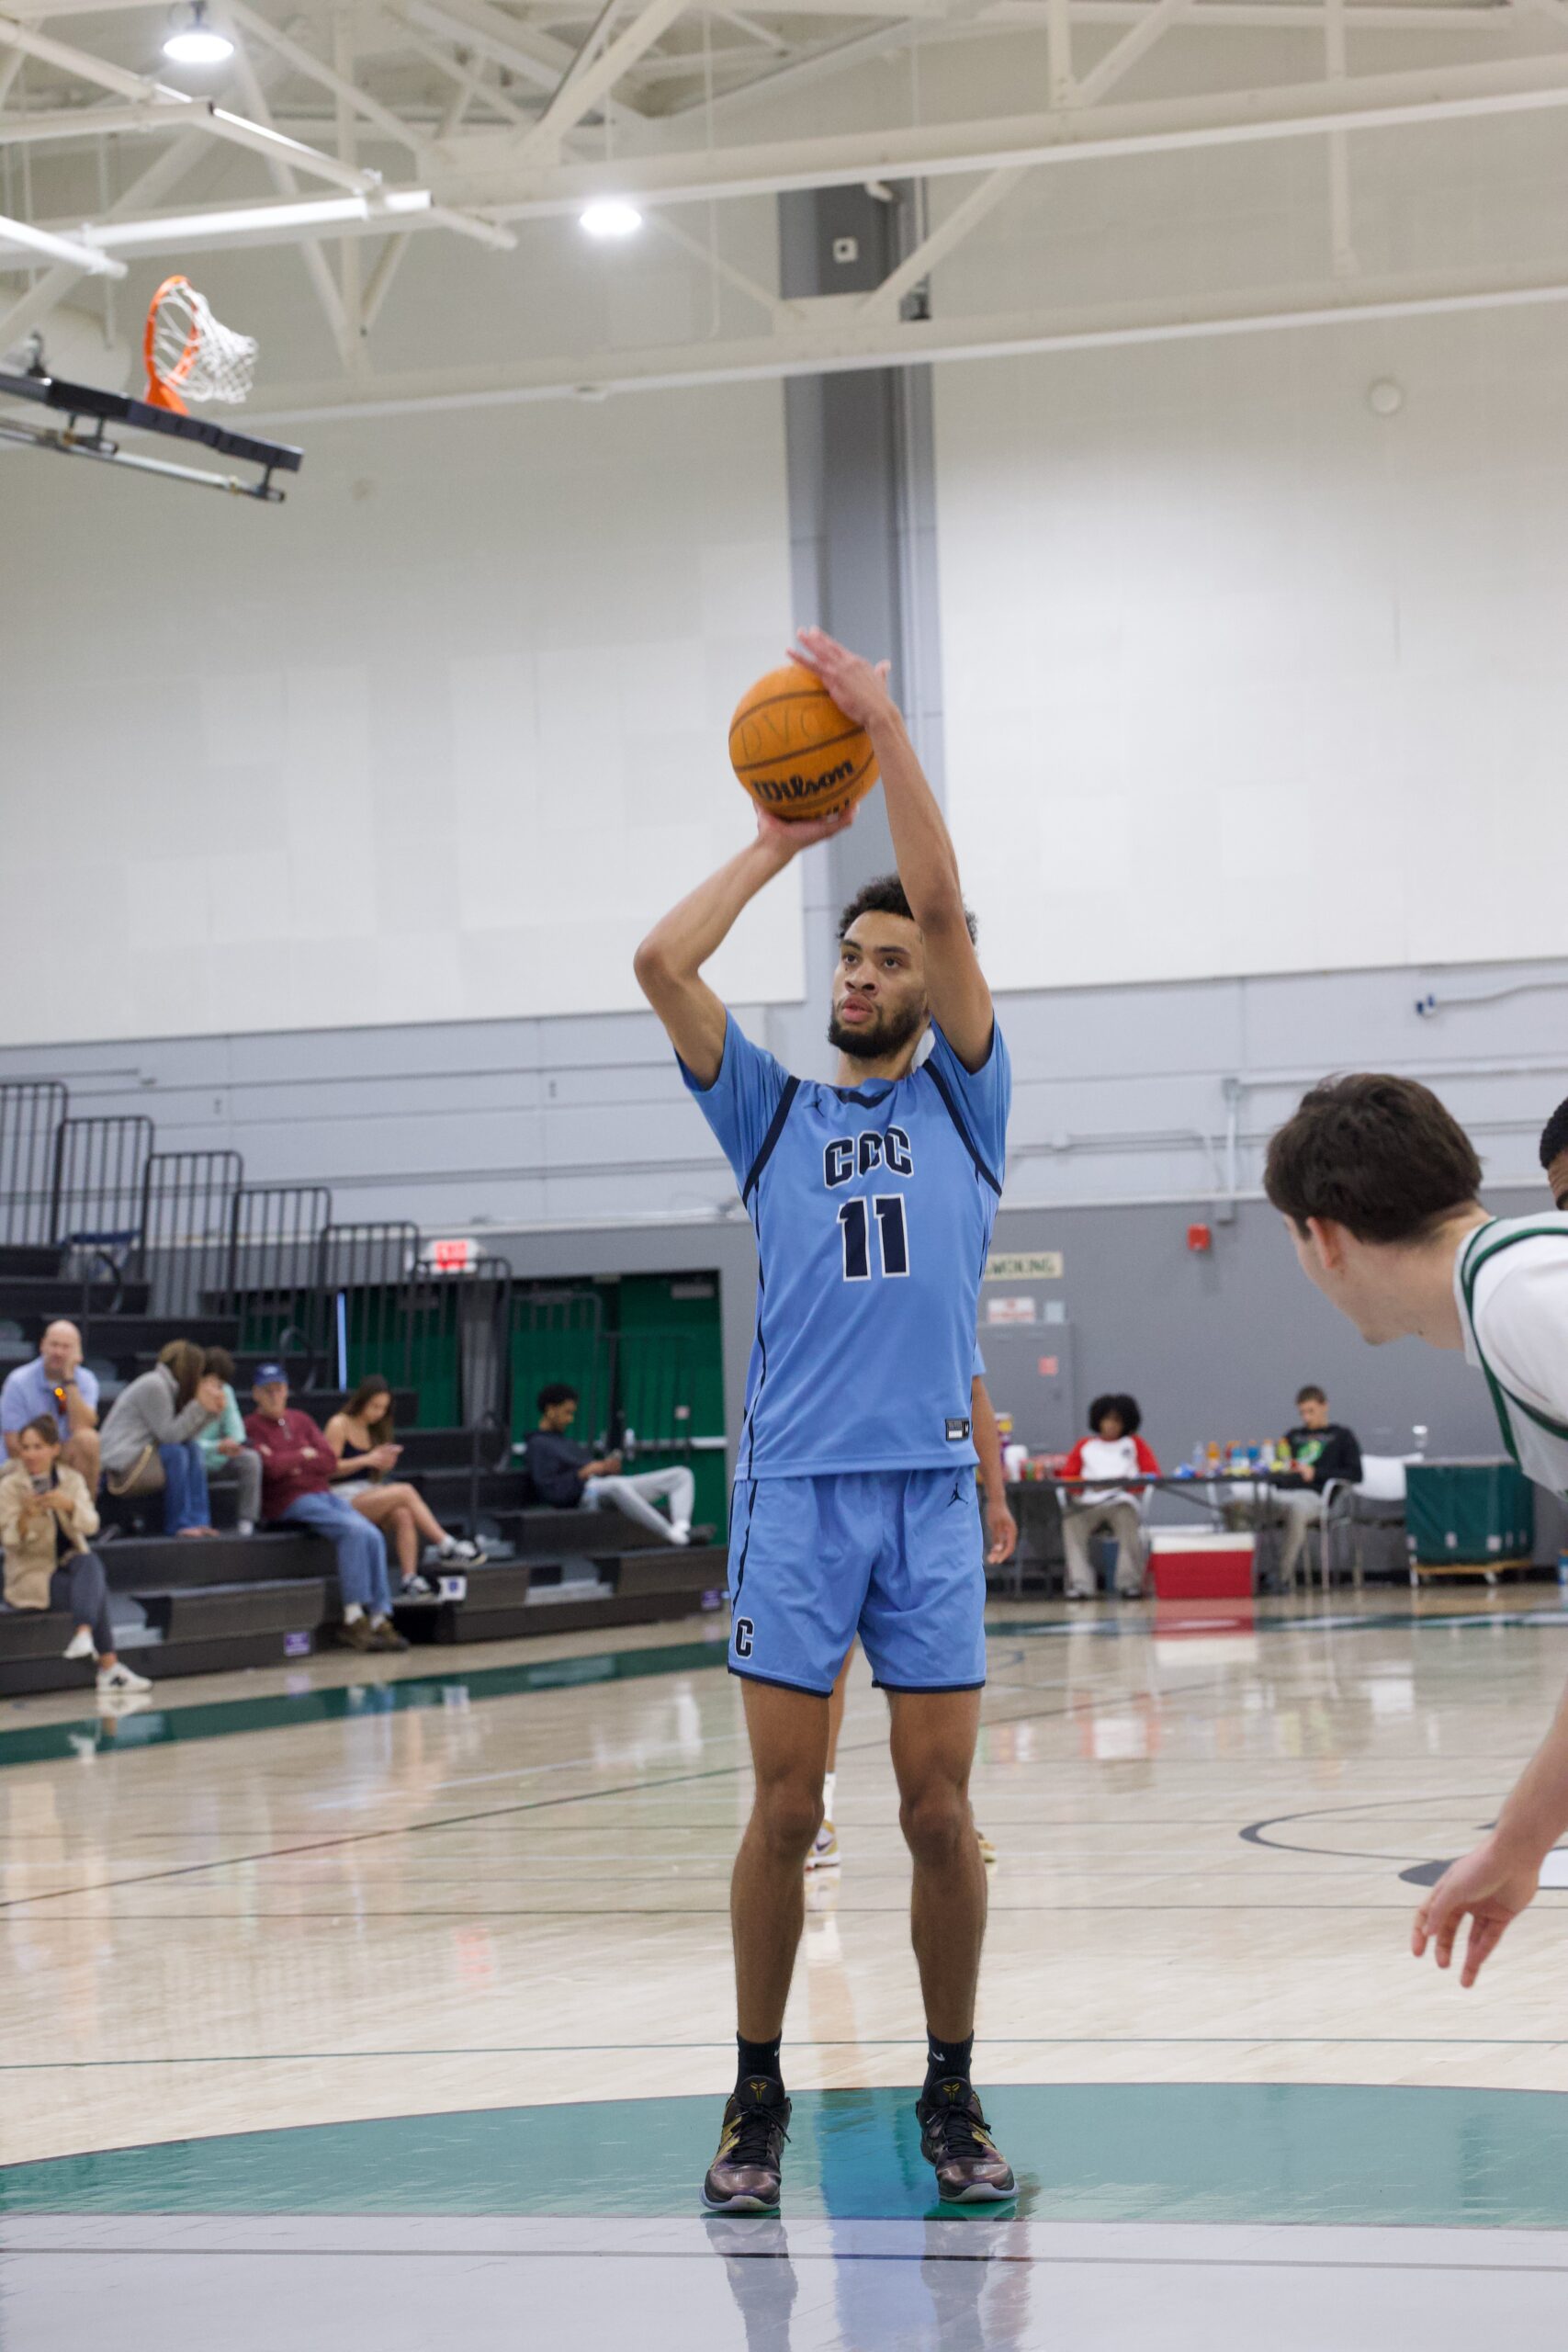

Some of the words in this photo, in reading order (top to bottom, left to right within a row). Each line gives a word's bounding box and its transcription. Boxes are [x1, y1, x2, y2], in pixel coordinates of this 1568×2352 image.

[750, 760, 854, 802] Wilson
[823, 1124, 915, 1191] CCC
[836, 1193, 910, 1283] 11
[735, 1617, 754, 1659] C
